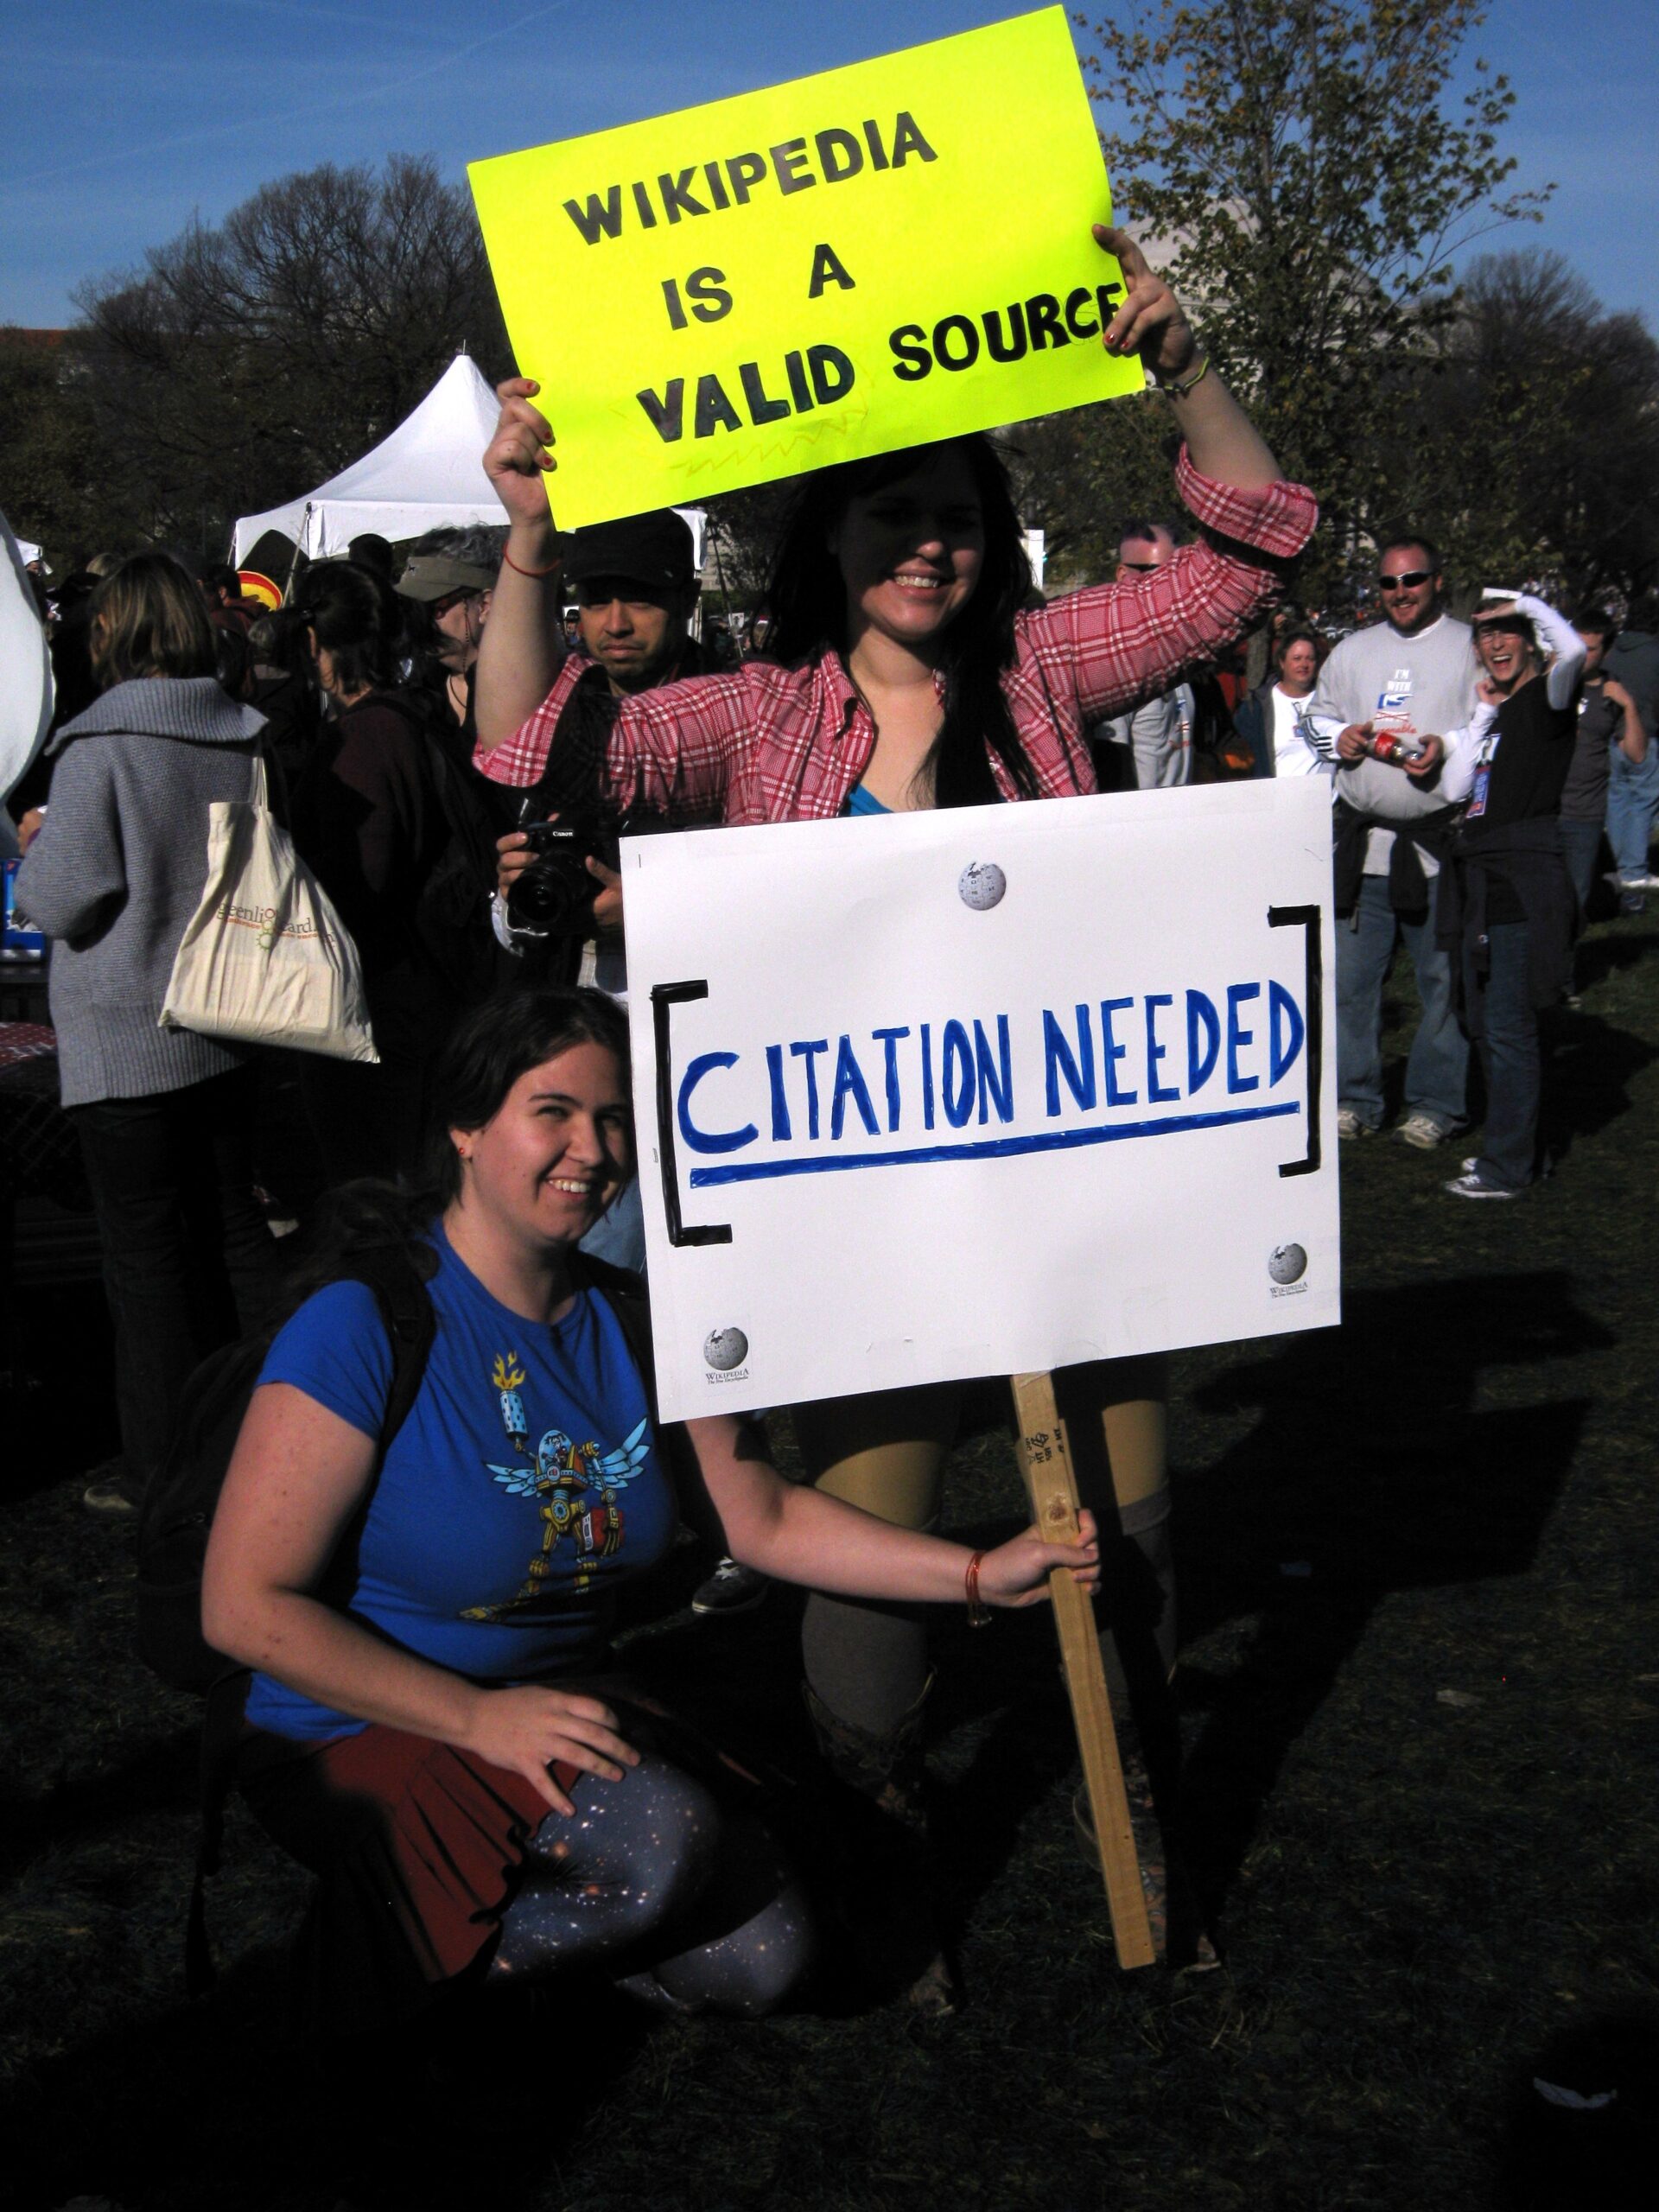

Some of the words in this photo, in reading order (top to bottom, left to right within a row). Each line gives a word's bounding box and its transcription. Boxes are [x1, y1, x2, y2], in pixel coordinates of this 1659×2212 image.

[562, 111, 938, 245] WIKIPEDIA
[661, 266, 733, 330] IS
[808, 244, 855, 299] A
[636, 344, 855, 442] VALID
[889, 283, 1122, 381] SOURCE
[1269, 1281, 1308, 1294] WIKIPEDIA
[705, 1368, 749, 1381] WIKIPEDIA
